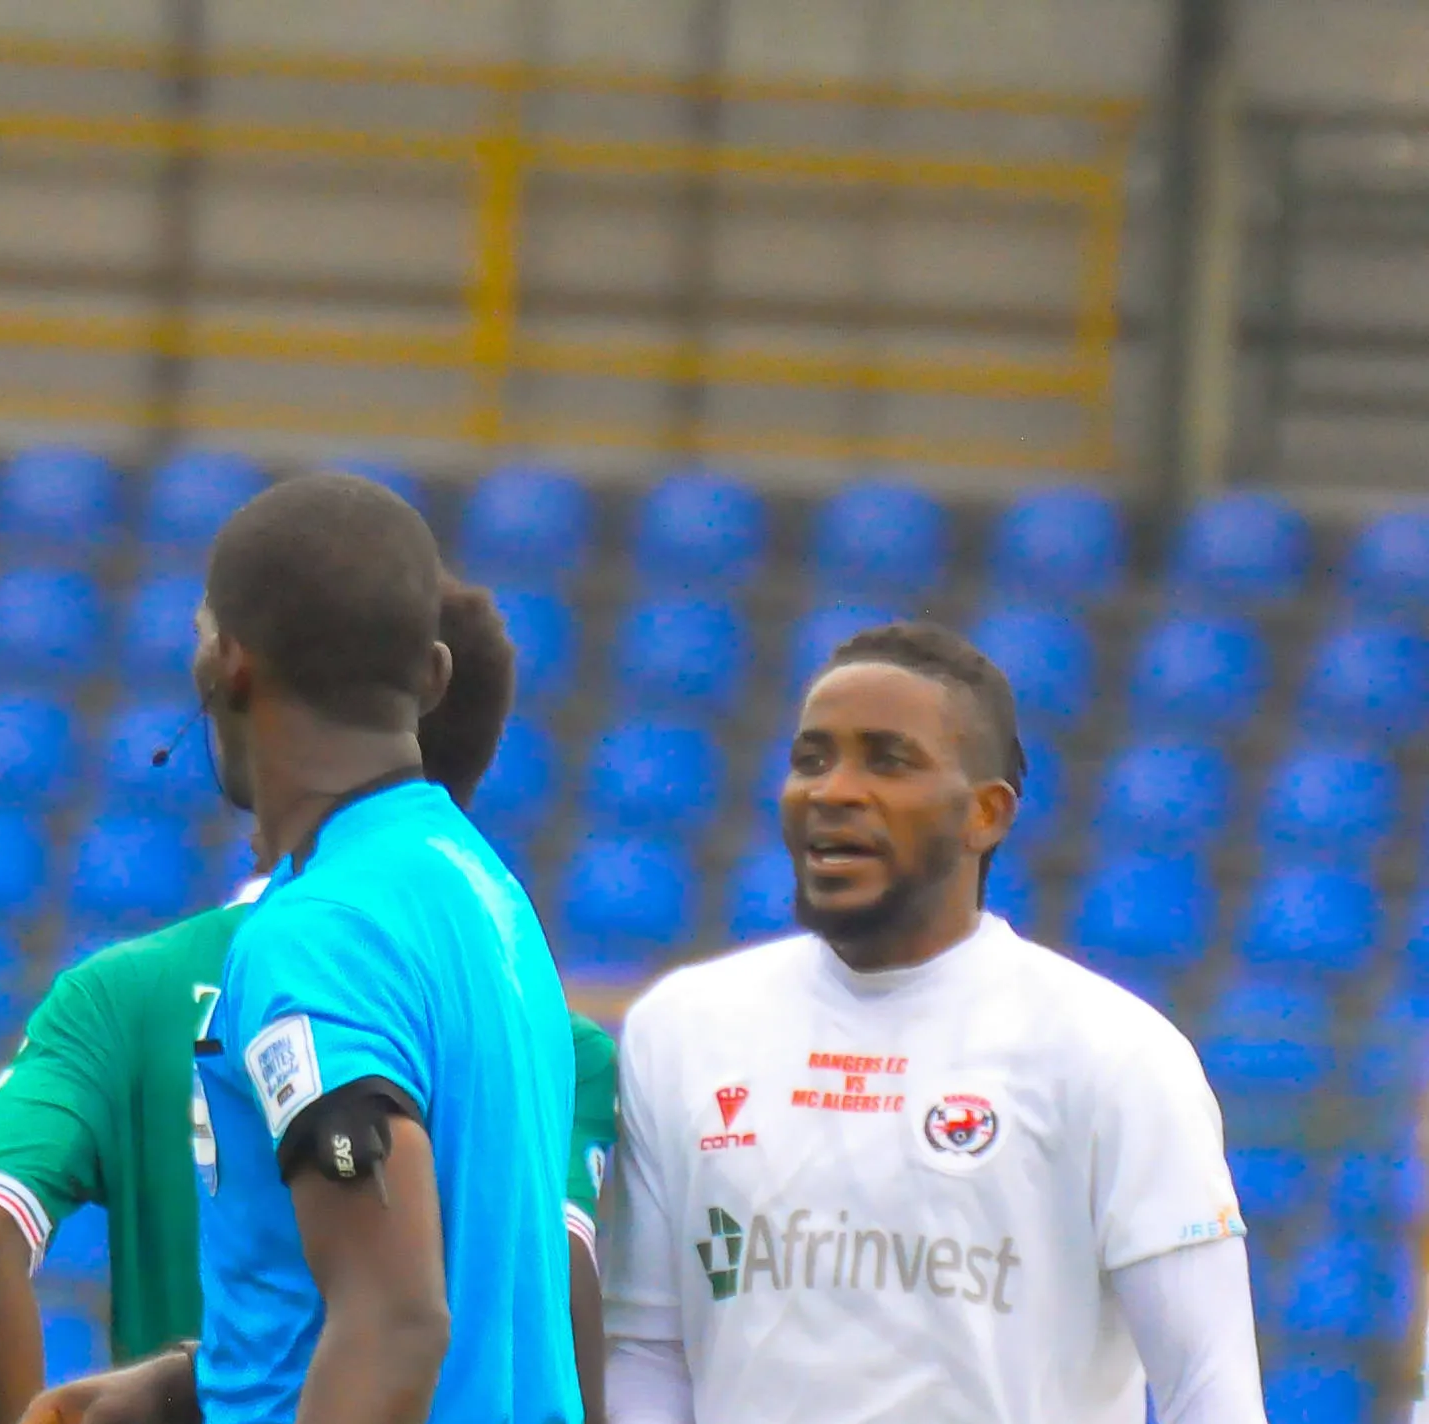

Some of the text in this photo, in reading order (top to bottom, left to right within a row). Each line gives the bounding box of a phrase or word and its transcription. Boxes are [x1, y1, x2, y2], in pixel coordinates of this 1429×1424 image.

[808, 1052, 883, 1074] RANGERS
[844, 1075, 866, 1093] VS
[791, 1088, 818, 1108] MC
[822, 1093, 882, 1112] ALGERS
[742, 1207, 1021, 1314] Afrinvest
